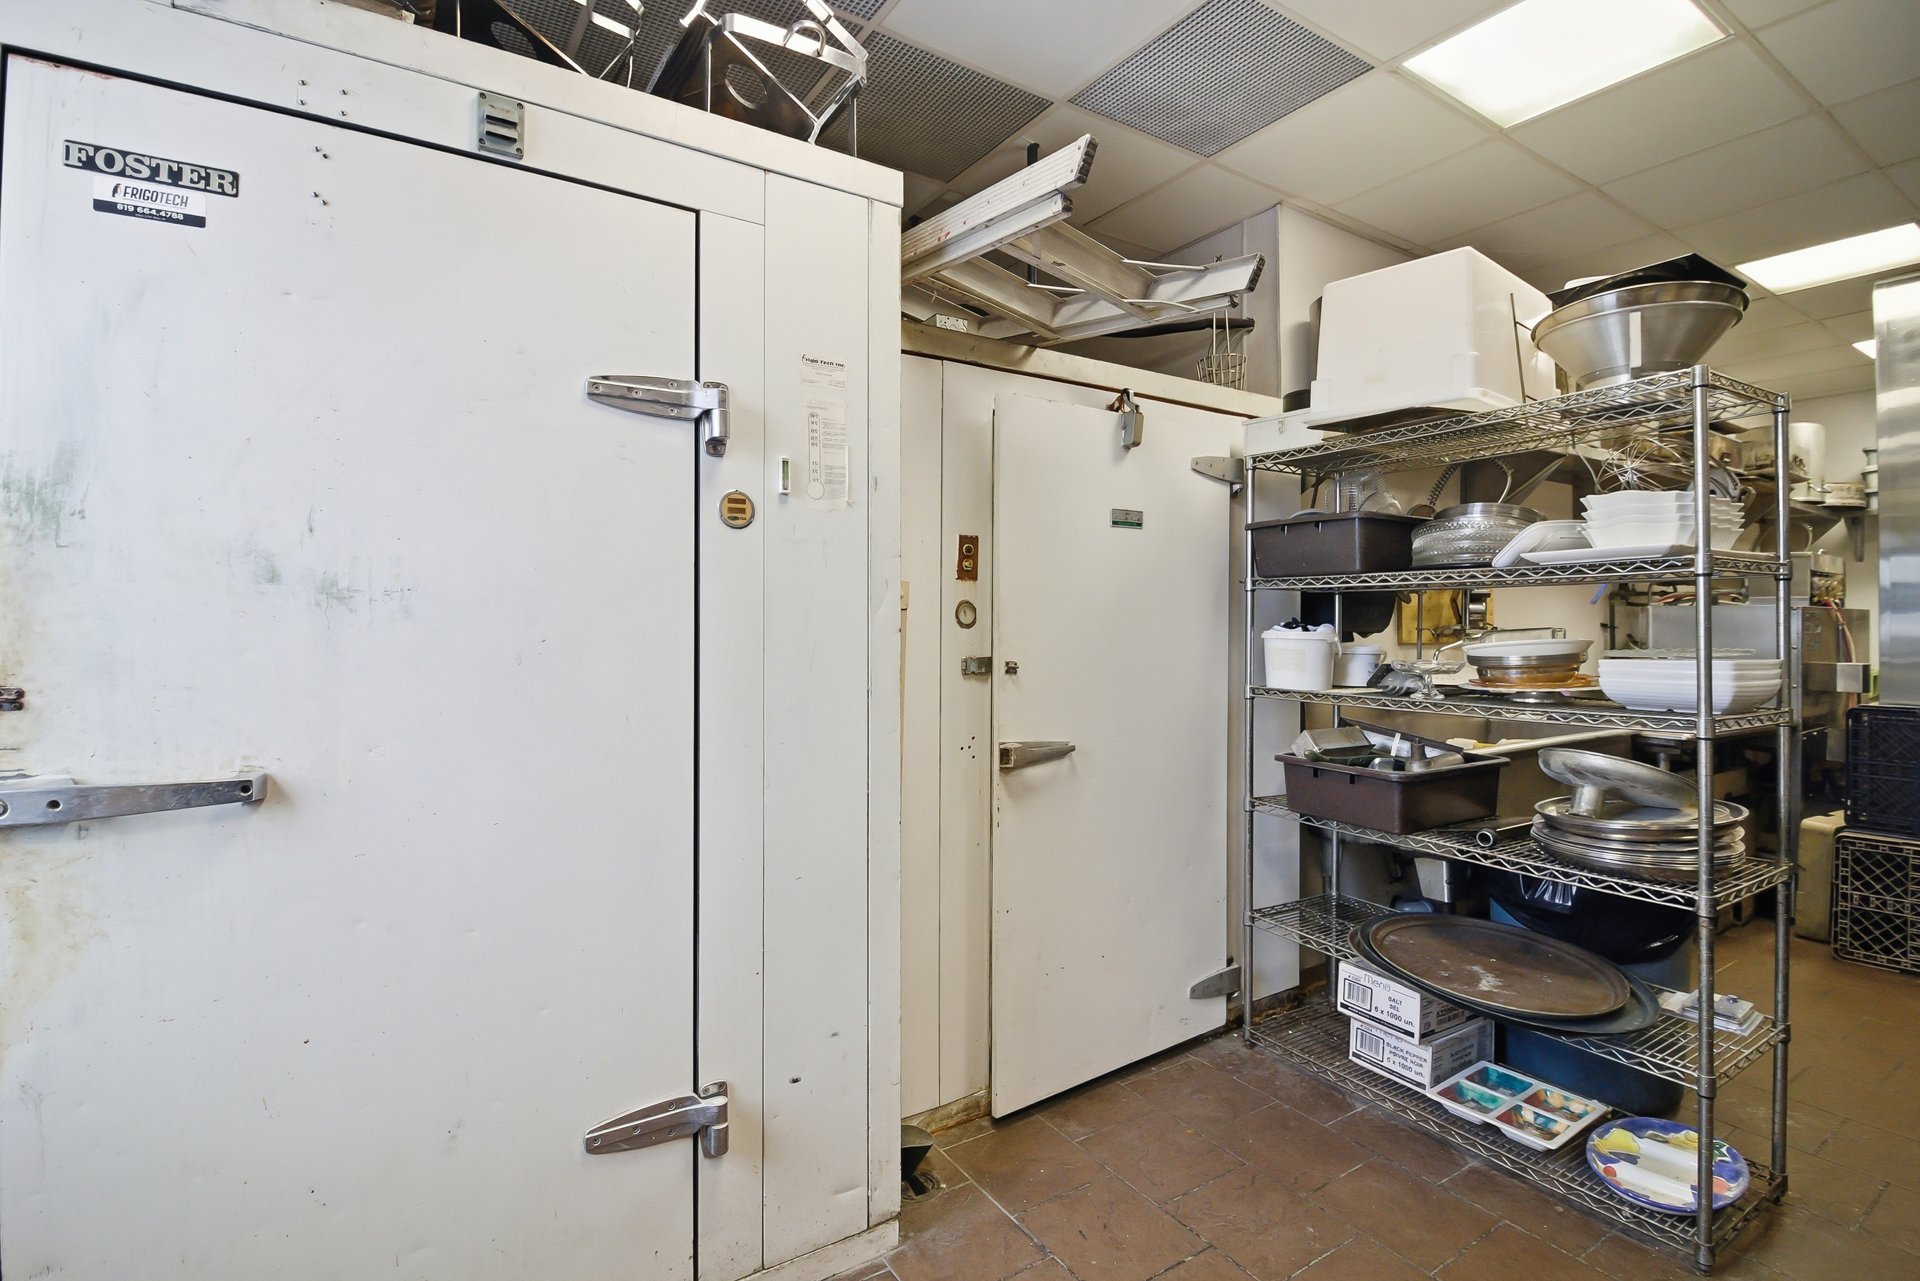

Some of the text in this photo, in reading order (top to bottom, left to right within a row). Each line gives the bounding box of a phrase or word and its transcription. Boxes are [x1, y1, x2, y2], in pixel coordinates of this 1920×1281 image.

[64, 141, 237, 195] FOSTER
[123, 185, 189, 208] FRIGOTECH
[116, 203, 135, 212] 819
[136, 206, 184, 220] 664.4788
[1388, 996, 1403, 1006] SALT
[1374, 1005, 1379, 1013] 6
[1386, 1011, 1402, 1022] 1000
